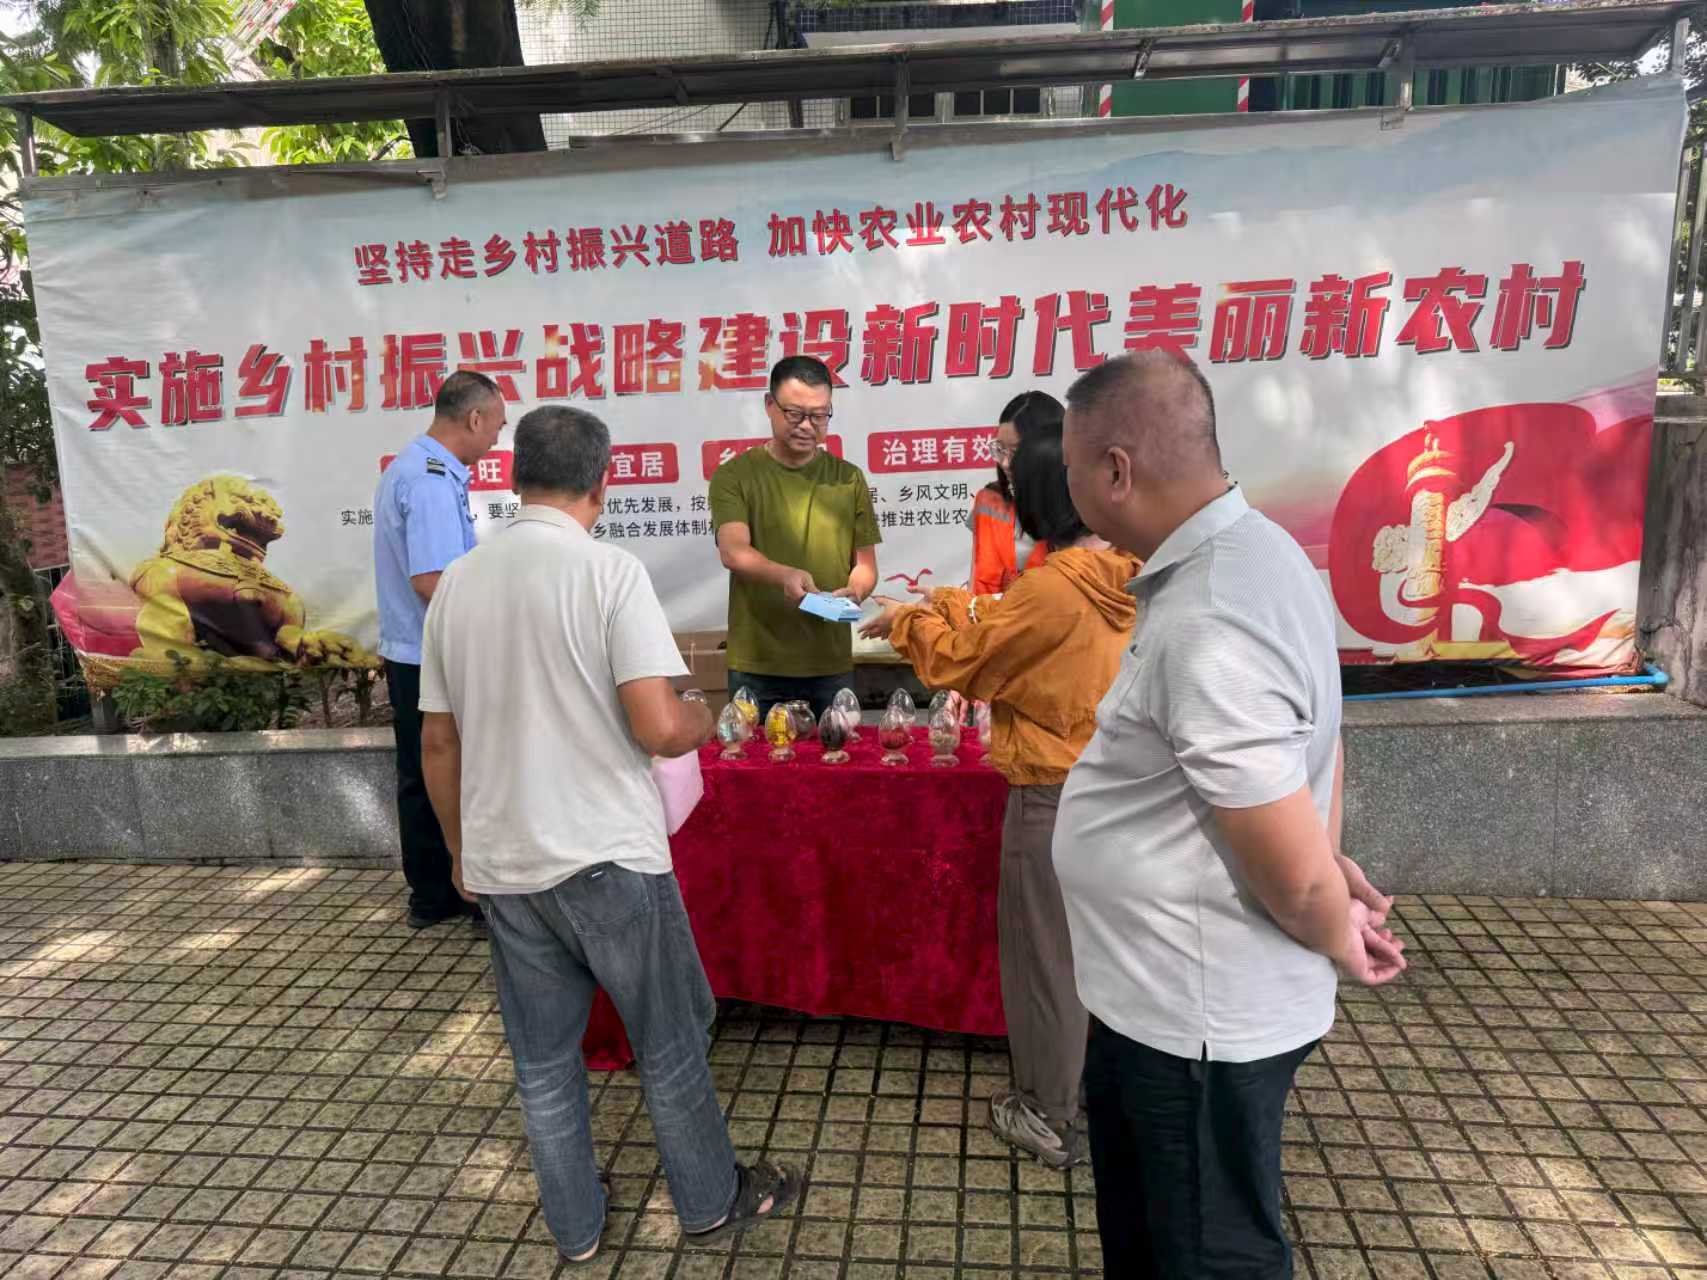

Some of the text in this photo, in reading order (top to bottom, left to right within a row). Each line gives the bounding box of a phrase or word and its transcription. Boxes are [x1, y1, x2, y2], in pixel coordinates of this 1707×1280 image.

[353, 183, 1189, 286] 坚持走乡村振兴道路 加快农业农村现代化
[84, 260, 1588, 432] 实施乡村振兴战略建设新时代美丽新农村
[611, 451, 665, 479] 宜居
[882, 433, 995, 466] 治理有效
[468, 457, 504, 484] 旺
[341, 508, 374, 527] 实施
[600, 494, 712, 515] 优先发展，按
